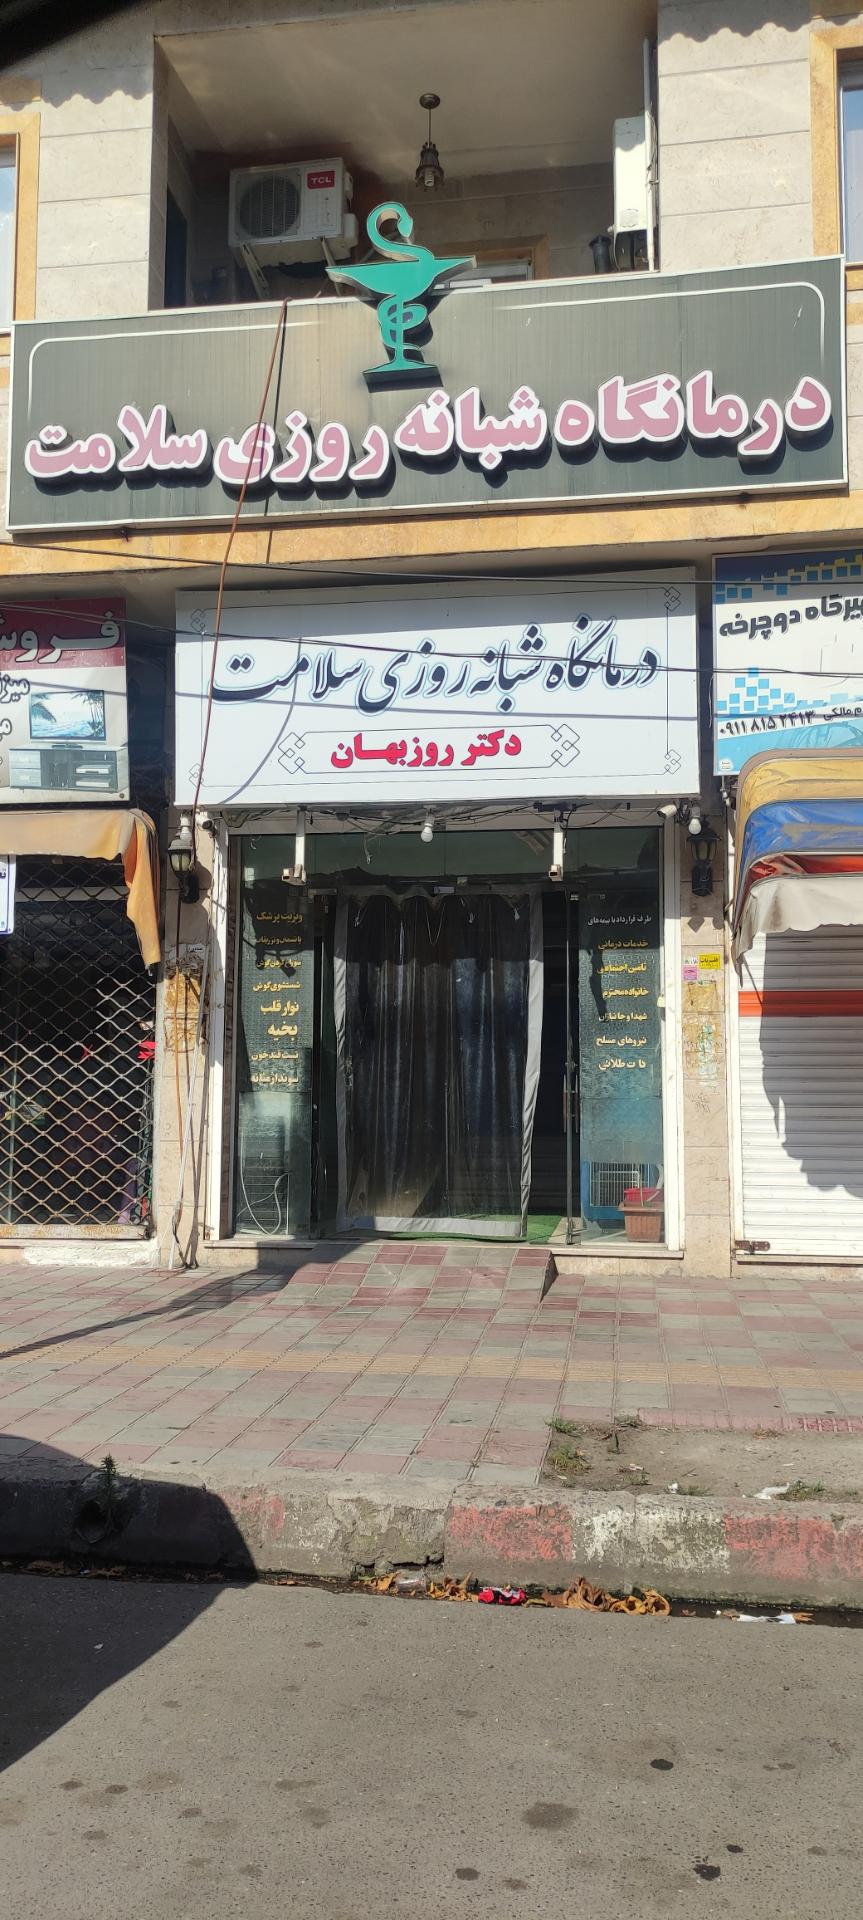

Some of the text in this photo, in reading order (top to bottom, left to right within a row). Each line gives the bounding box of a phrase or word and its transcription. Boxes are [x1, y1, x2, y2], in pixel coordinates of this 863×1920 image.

[311, 176, 331, 184] TCL
[24, 370, 832, 484] درمانگاه شبانه روزی سلامت
[719, 593, 863, 639] یرگاه دوچرخه
[210, 615, 659, 714] درمانگاه شبانه روزی سلامت
[719, 720, 747, 735] ۰۹۱۱
[751, 716, 776, 732] ۸۱۵
[779, 709, 815, 727] ۲۴۱۳
[330, 729, 522, 769] دکتر روزبهان
[256, 911, 280, 924] پزشک
[616, 915, 635, 925] قرارداد
[598, 939, 649, 950] خدمات درمانی
[256, 958, 270, 968] گوش
[597, 963, 628, 974] اجتماعی
[253, 981, 301, 993] شستشوی گوش
[602, 987, 649, 999] خانواده محترم
[260, 1000, 300, 1016] نوار قلب
[598, 1011, 627, 1022] جانبازان
[631, 1011, 648, 1021] شهدا
[267, 1021, 298, 1041] بخیه
[595, 1035, 647, 1047] نیروهای مسلح
[251, 1051, 269, 1062] خون
[281, 1051, 299, 1061] تست
